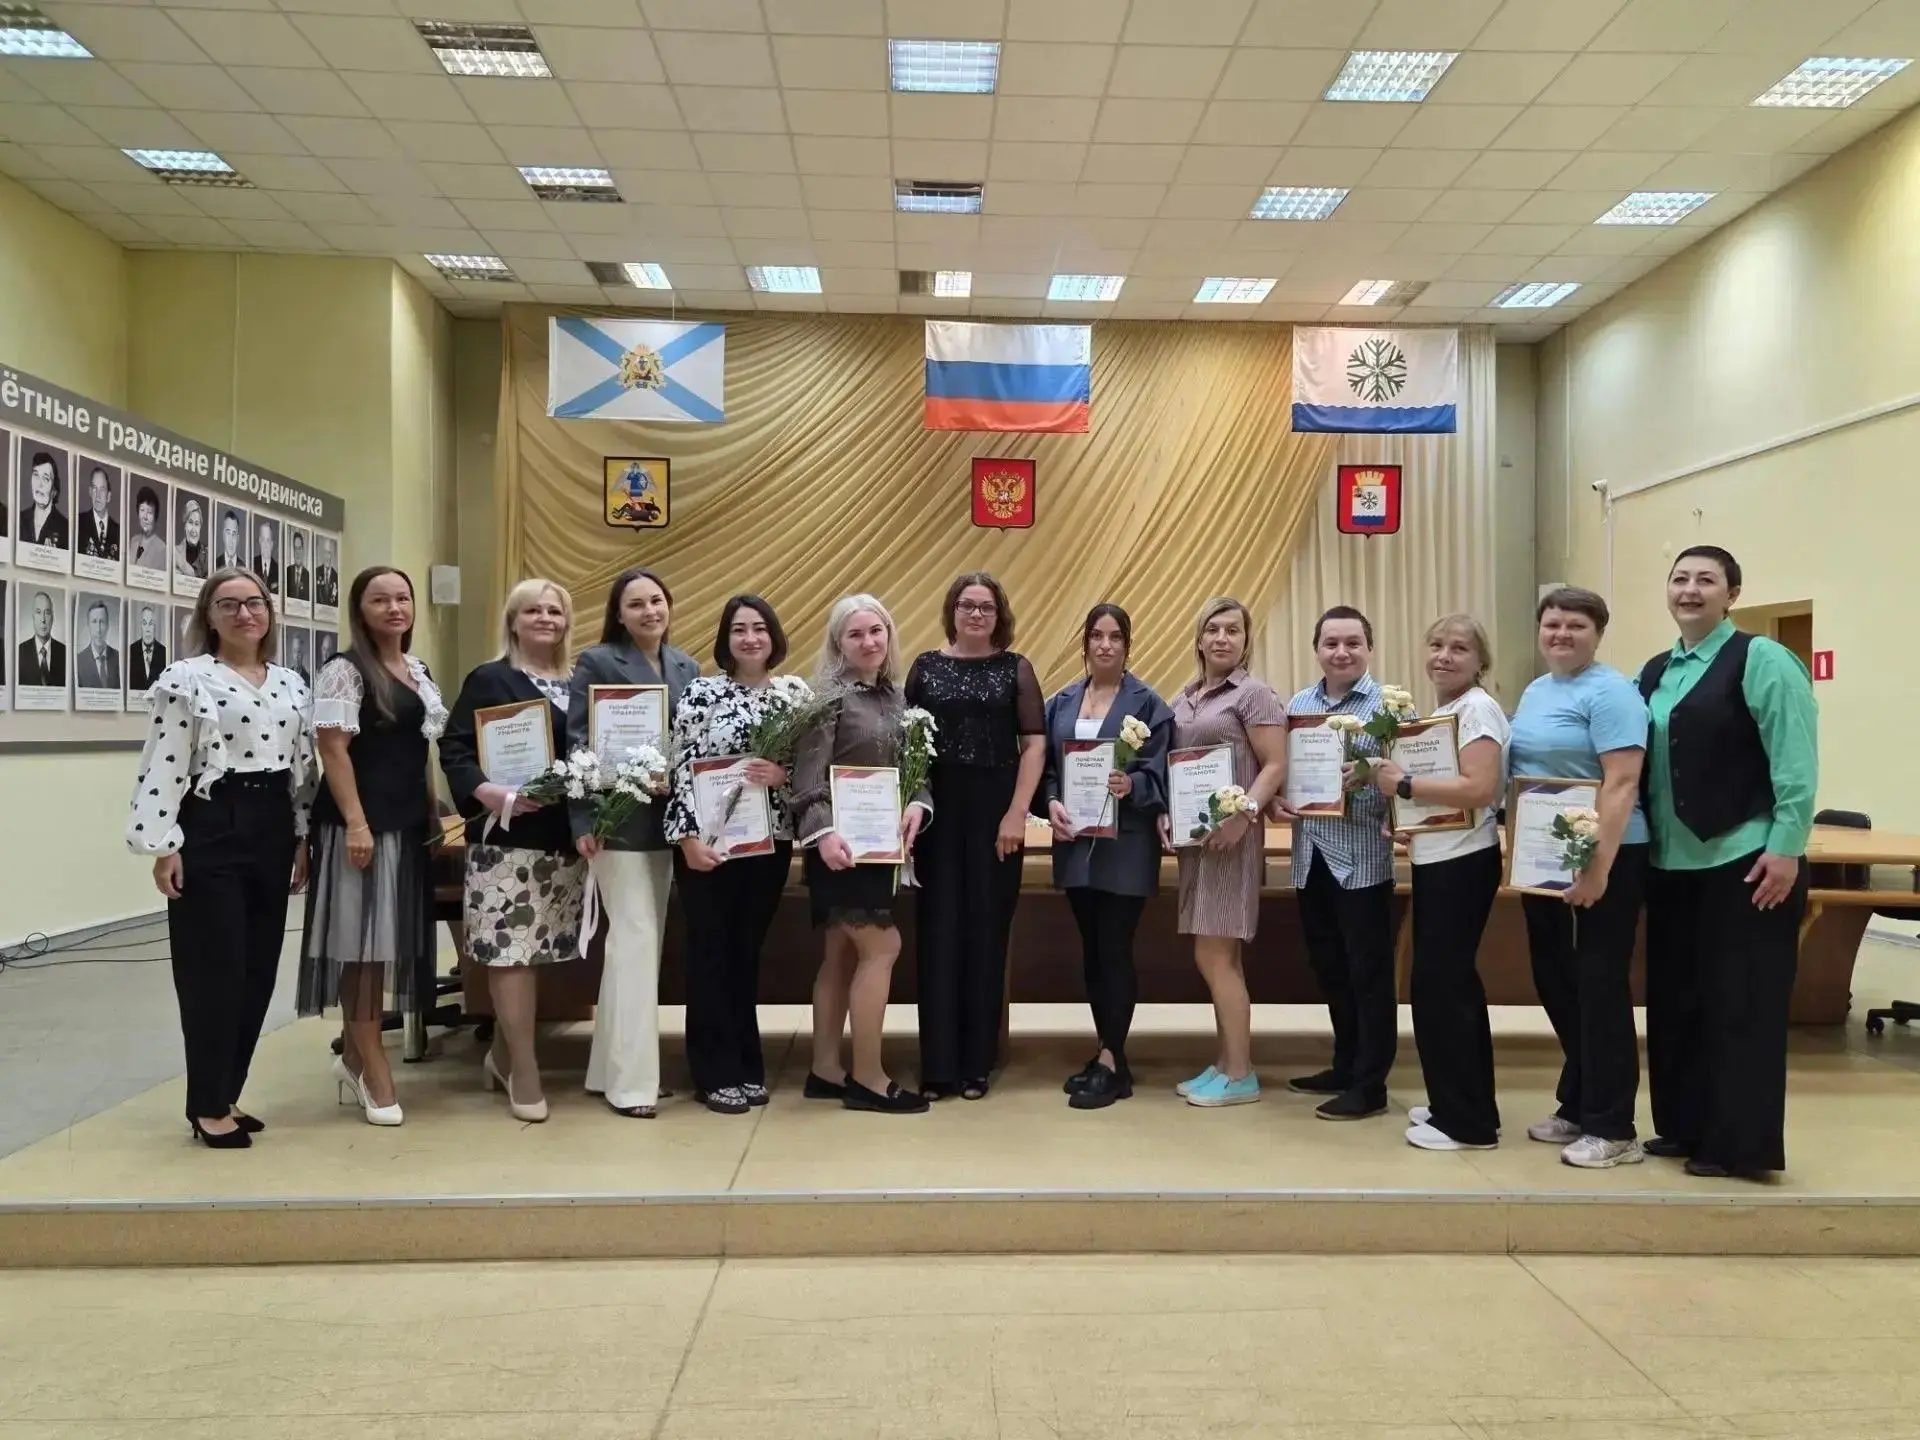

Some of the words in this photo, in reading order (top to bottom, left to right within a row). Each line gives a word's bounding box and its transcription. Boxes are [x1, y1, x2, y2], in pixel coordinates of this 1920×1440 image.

[1, 370, 91, 433] ётные
[97, 416, 209, 476] граждане
[213, 453, 324, 518] Новодвинска
[1402, 746, 1438, 755] ГРАМОТА
